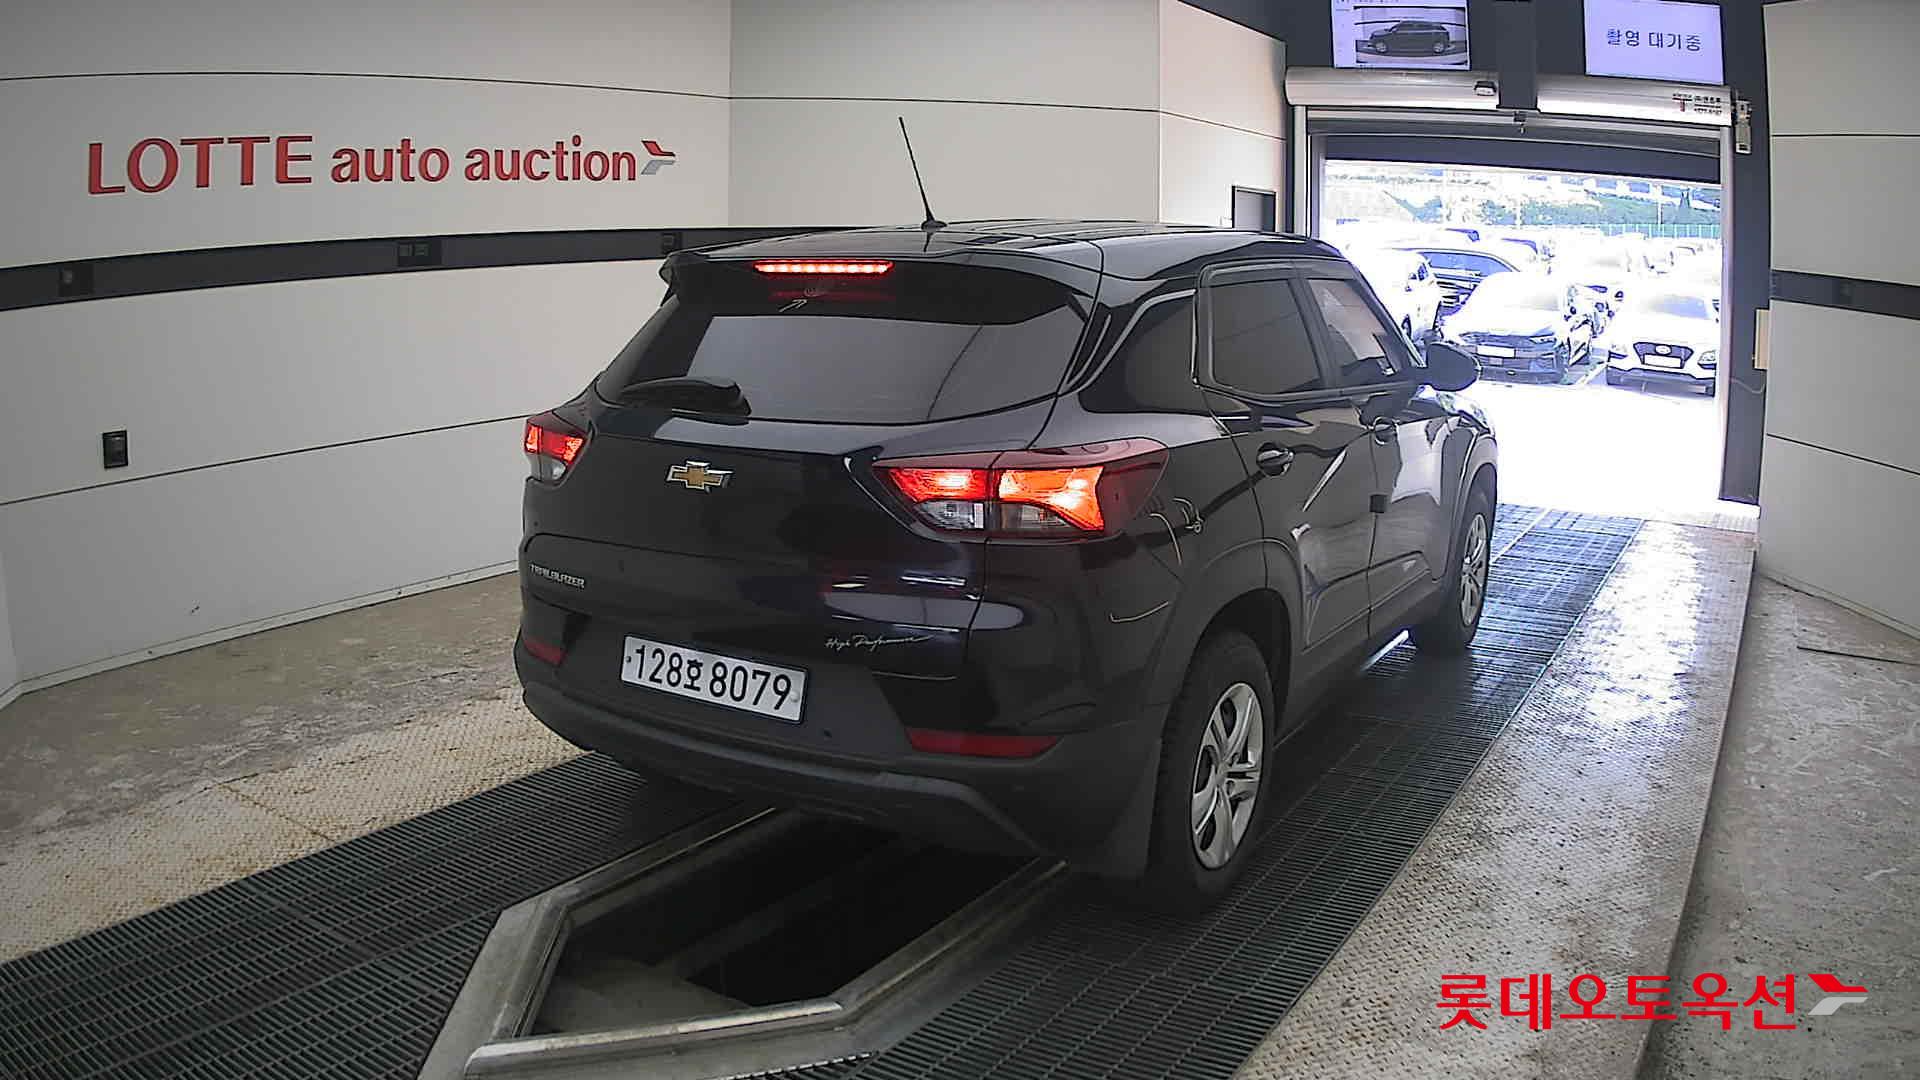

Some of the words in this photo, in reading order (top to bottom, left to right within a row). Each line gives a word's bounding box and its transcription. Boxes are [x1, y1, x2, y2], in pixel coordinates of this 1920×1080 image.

[1648, 32, 1702, 52] 대기중
[88, 134, 313, 195] LOTTE
[330, 137, 450, 183] auto
[463, 134, 638, 182] auction
